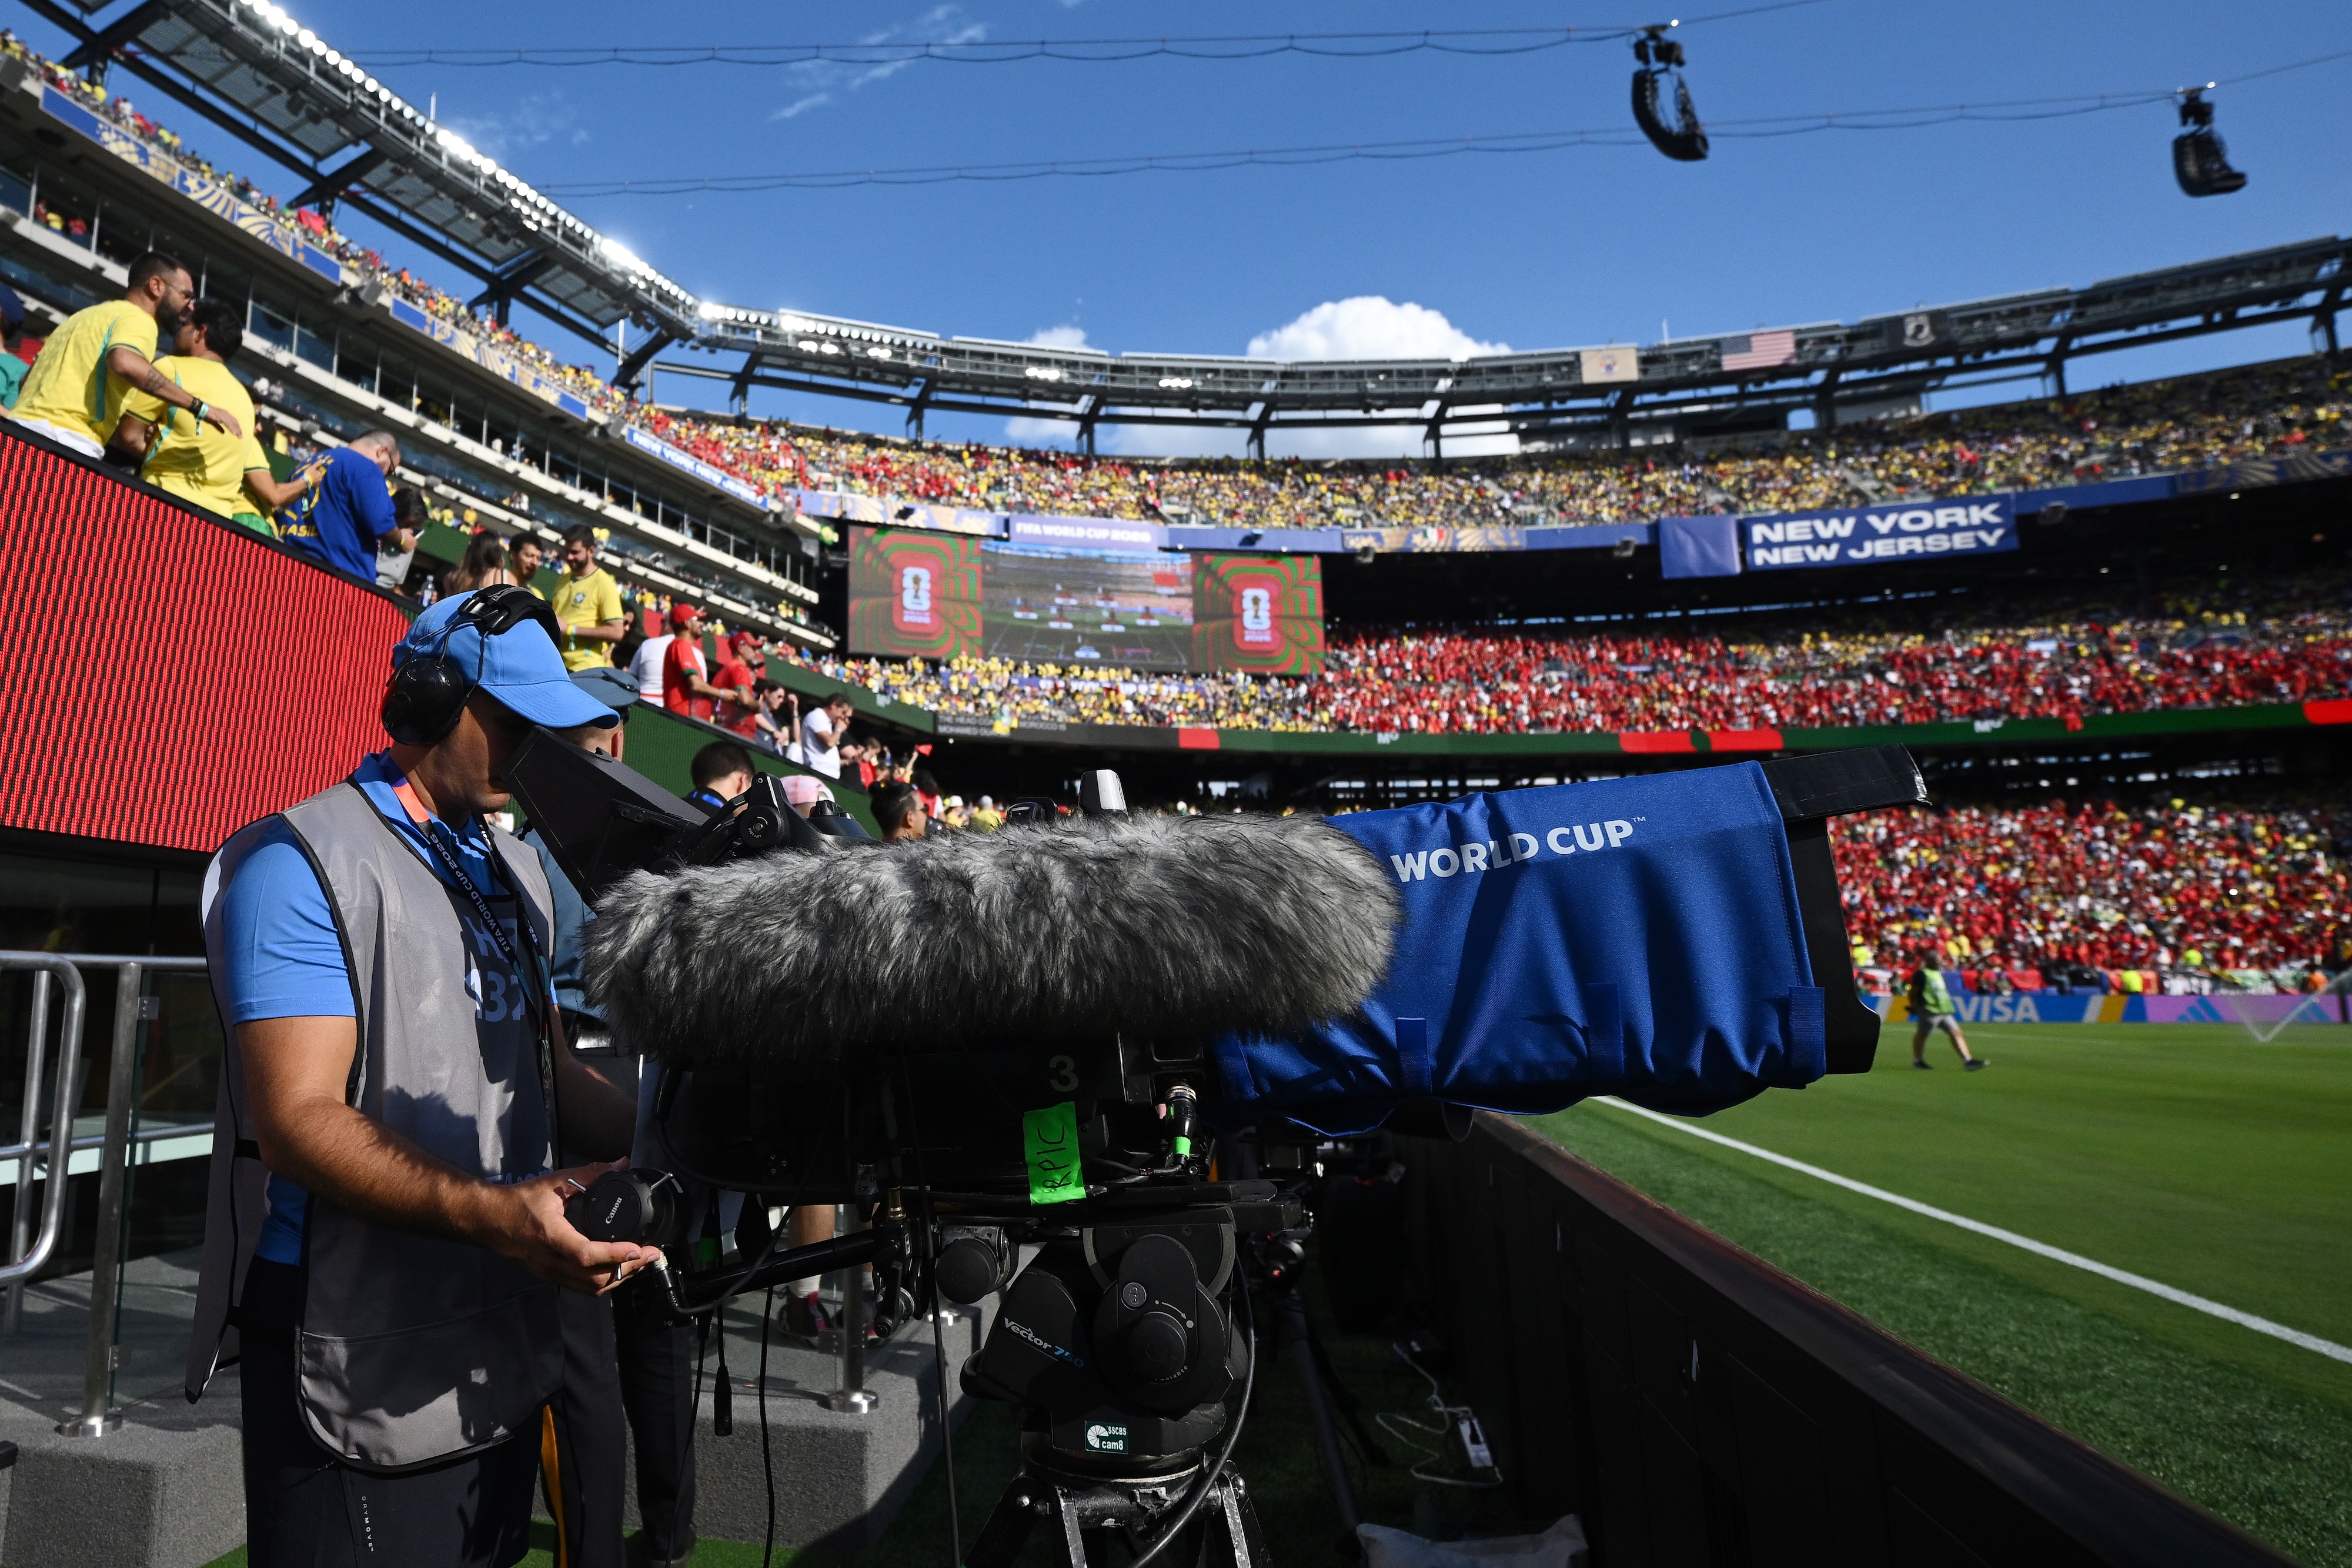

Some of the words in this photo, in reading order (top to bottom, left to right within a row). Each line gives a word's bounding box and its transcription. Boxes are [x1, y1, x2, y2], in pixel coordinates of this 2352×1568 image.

[1015, 522, 1042, 536] FIFA
[1043, 524, 1085, 538] WORLD
[1086, 527, 1110, 540] CUP
[1111, 530, 1152, 543] 2026
[1752, 516, 1857, 544] NEW
[1866, 502, 2004, 534] YORK
[1753, 543, 1841, 566] NEW
[1847, 527, 2006, 559] JERSEY
[430, 833, 457, 870] 2026
[1390, 833, 1539, 882] WORLD
[456, 870, 473, 891] CUP
[471, 891, 497, 930] WORLD
[495, 928, 510, 952] FIFA
[1953, 995, 2041, 1022] VISA
[1049, 1055, 1079, 1093] 3
[1037, 1125, 1073, 1188] RPIC
[605, 1196, 623, 1225] Canon
[1004, 1317, 1052, 1350] Vector
[1053, 1345, 1085, 1369] 750
[1101, 1440, 1124, 1451] cam8
[1108, 1426, 1127, 1436] SSCBS
